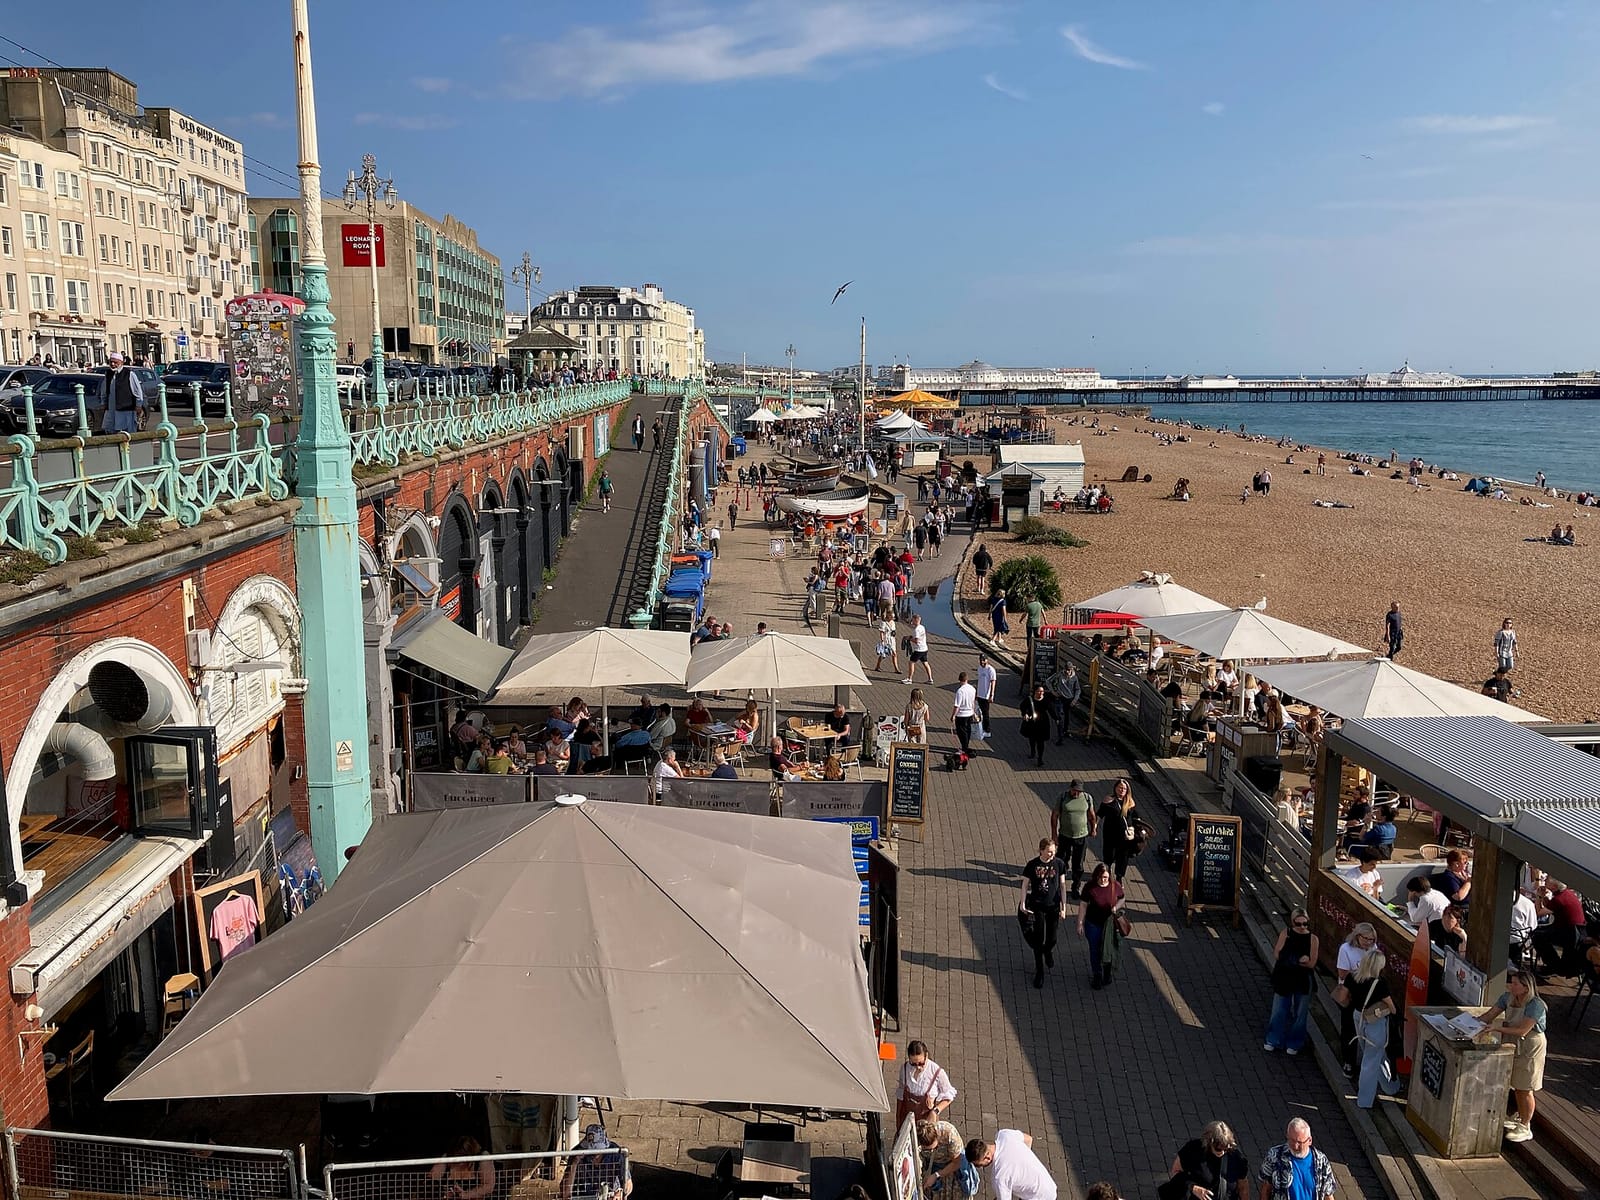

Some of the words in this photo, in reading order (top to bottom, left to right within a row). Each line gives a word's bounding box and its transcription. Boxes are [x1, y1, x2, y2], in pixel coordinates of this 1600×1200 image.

[179, 118, 195, 134] OLD
[196, 126, 213, 143] SHIP
[214, 135, 237, 154] HOTEL
